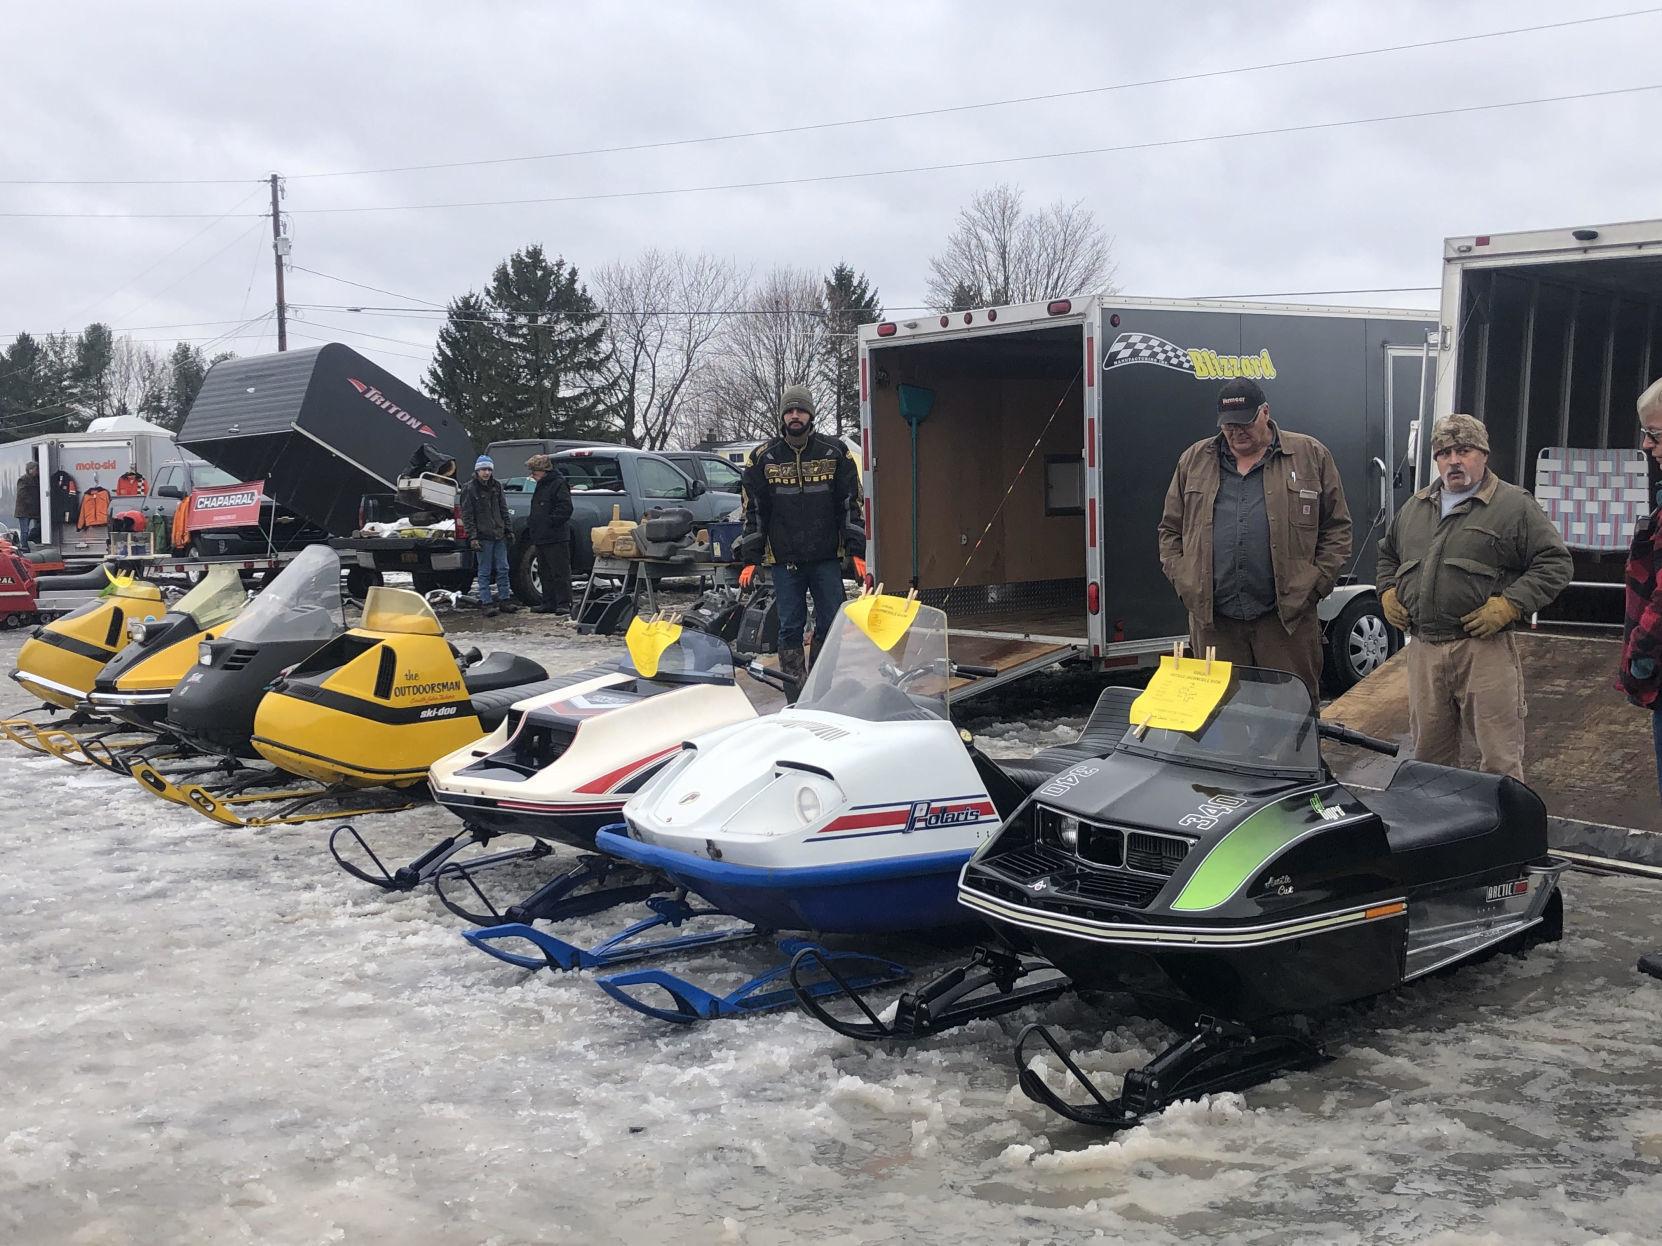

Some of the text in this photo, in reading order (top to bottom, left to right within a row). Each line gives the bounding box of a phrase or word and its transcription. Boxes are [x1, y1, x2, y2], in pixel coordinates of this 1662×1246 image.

[1187, 348, 1277, 379] Blizzard
[364, 386, 422, 430] TRITON
[75, 460, 116, 471] moto-ski
[197, 493, 253, 509] CHAPARRAL
[404, 669, 419, 681] the
[394, 680, 461, 698] OUTDOORSMAN
[420, 706, 458, 719] ski-doo
[904, 800, 980, 834] Polaris
[1178, 794, 1248, 830] 340
[1487, 882, 1514, 900] ARCTIC
